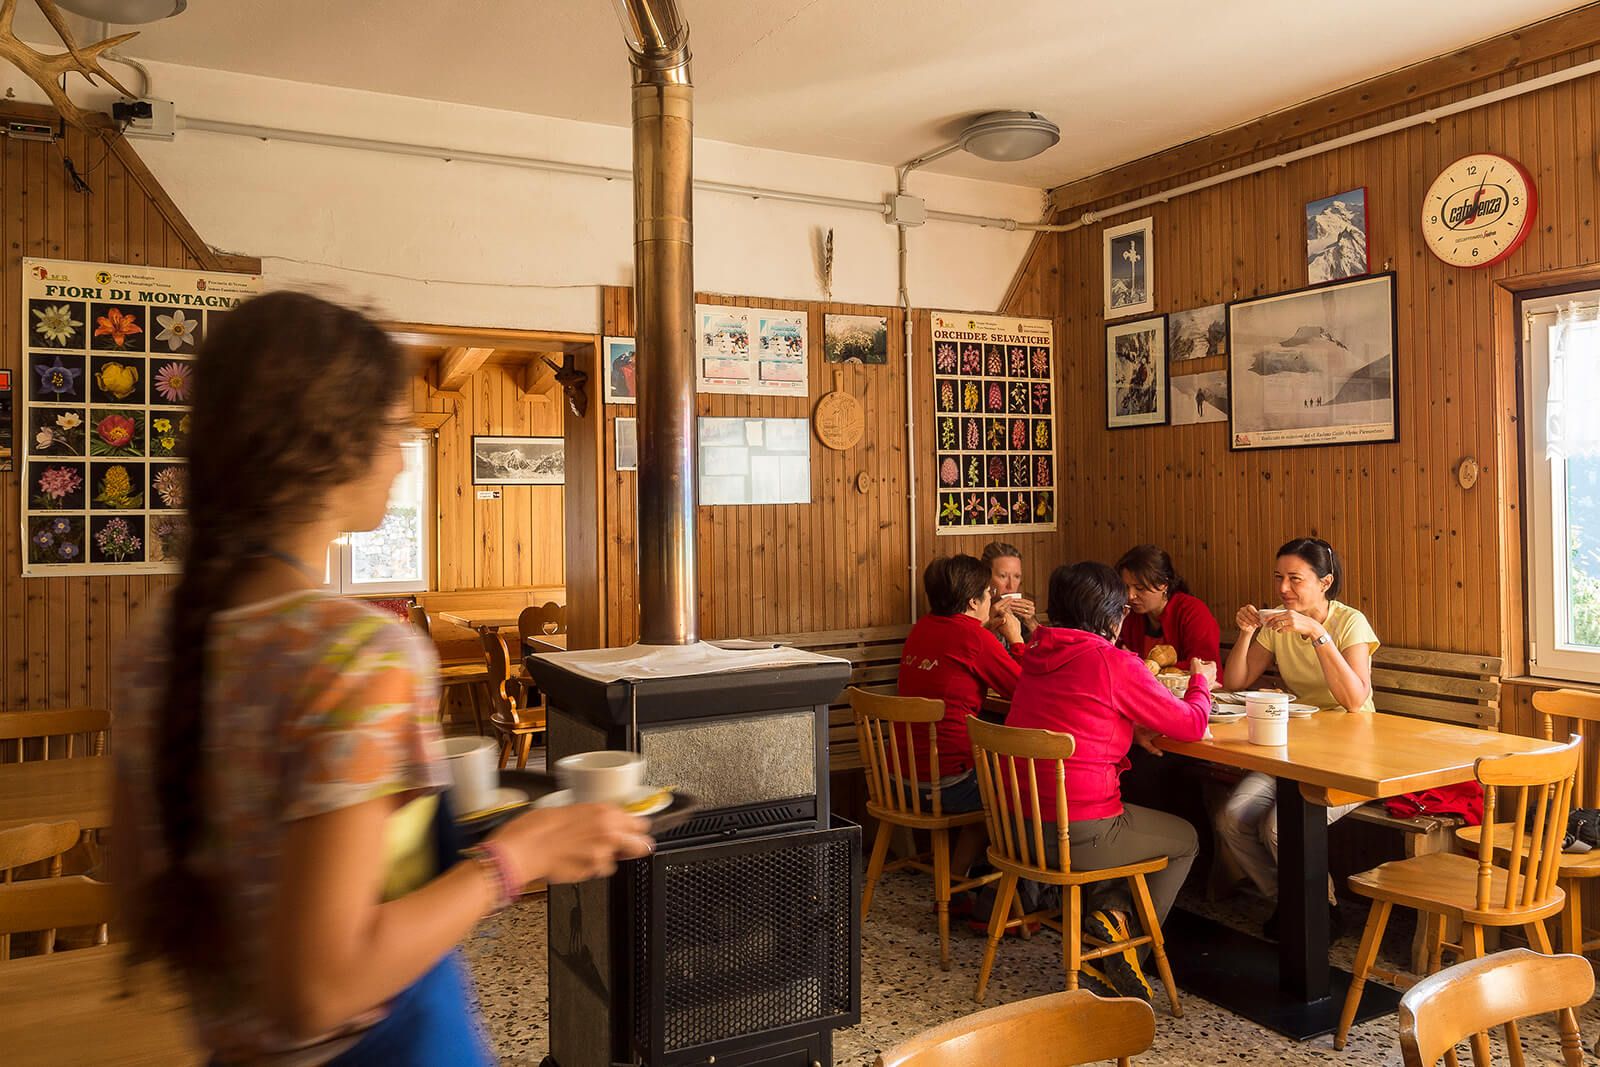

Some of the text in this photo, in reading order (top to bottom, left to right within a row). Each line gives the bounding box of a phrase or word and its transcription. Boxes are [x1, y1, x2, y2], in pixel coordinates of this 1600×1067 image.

[1466, 165, 1477, 176] 12
[1512, 196, 1520, 206] 3
[1431, 215, 1438, 225] 9
[1471, 247, 1479, 257] 6
[45, 284, 242, 308] FIORI DI MONTAGNA
[934, 329, 1050, 345] ORCHIDEE SELVATICHE
